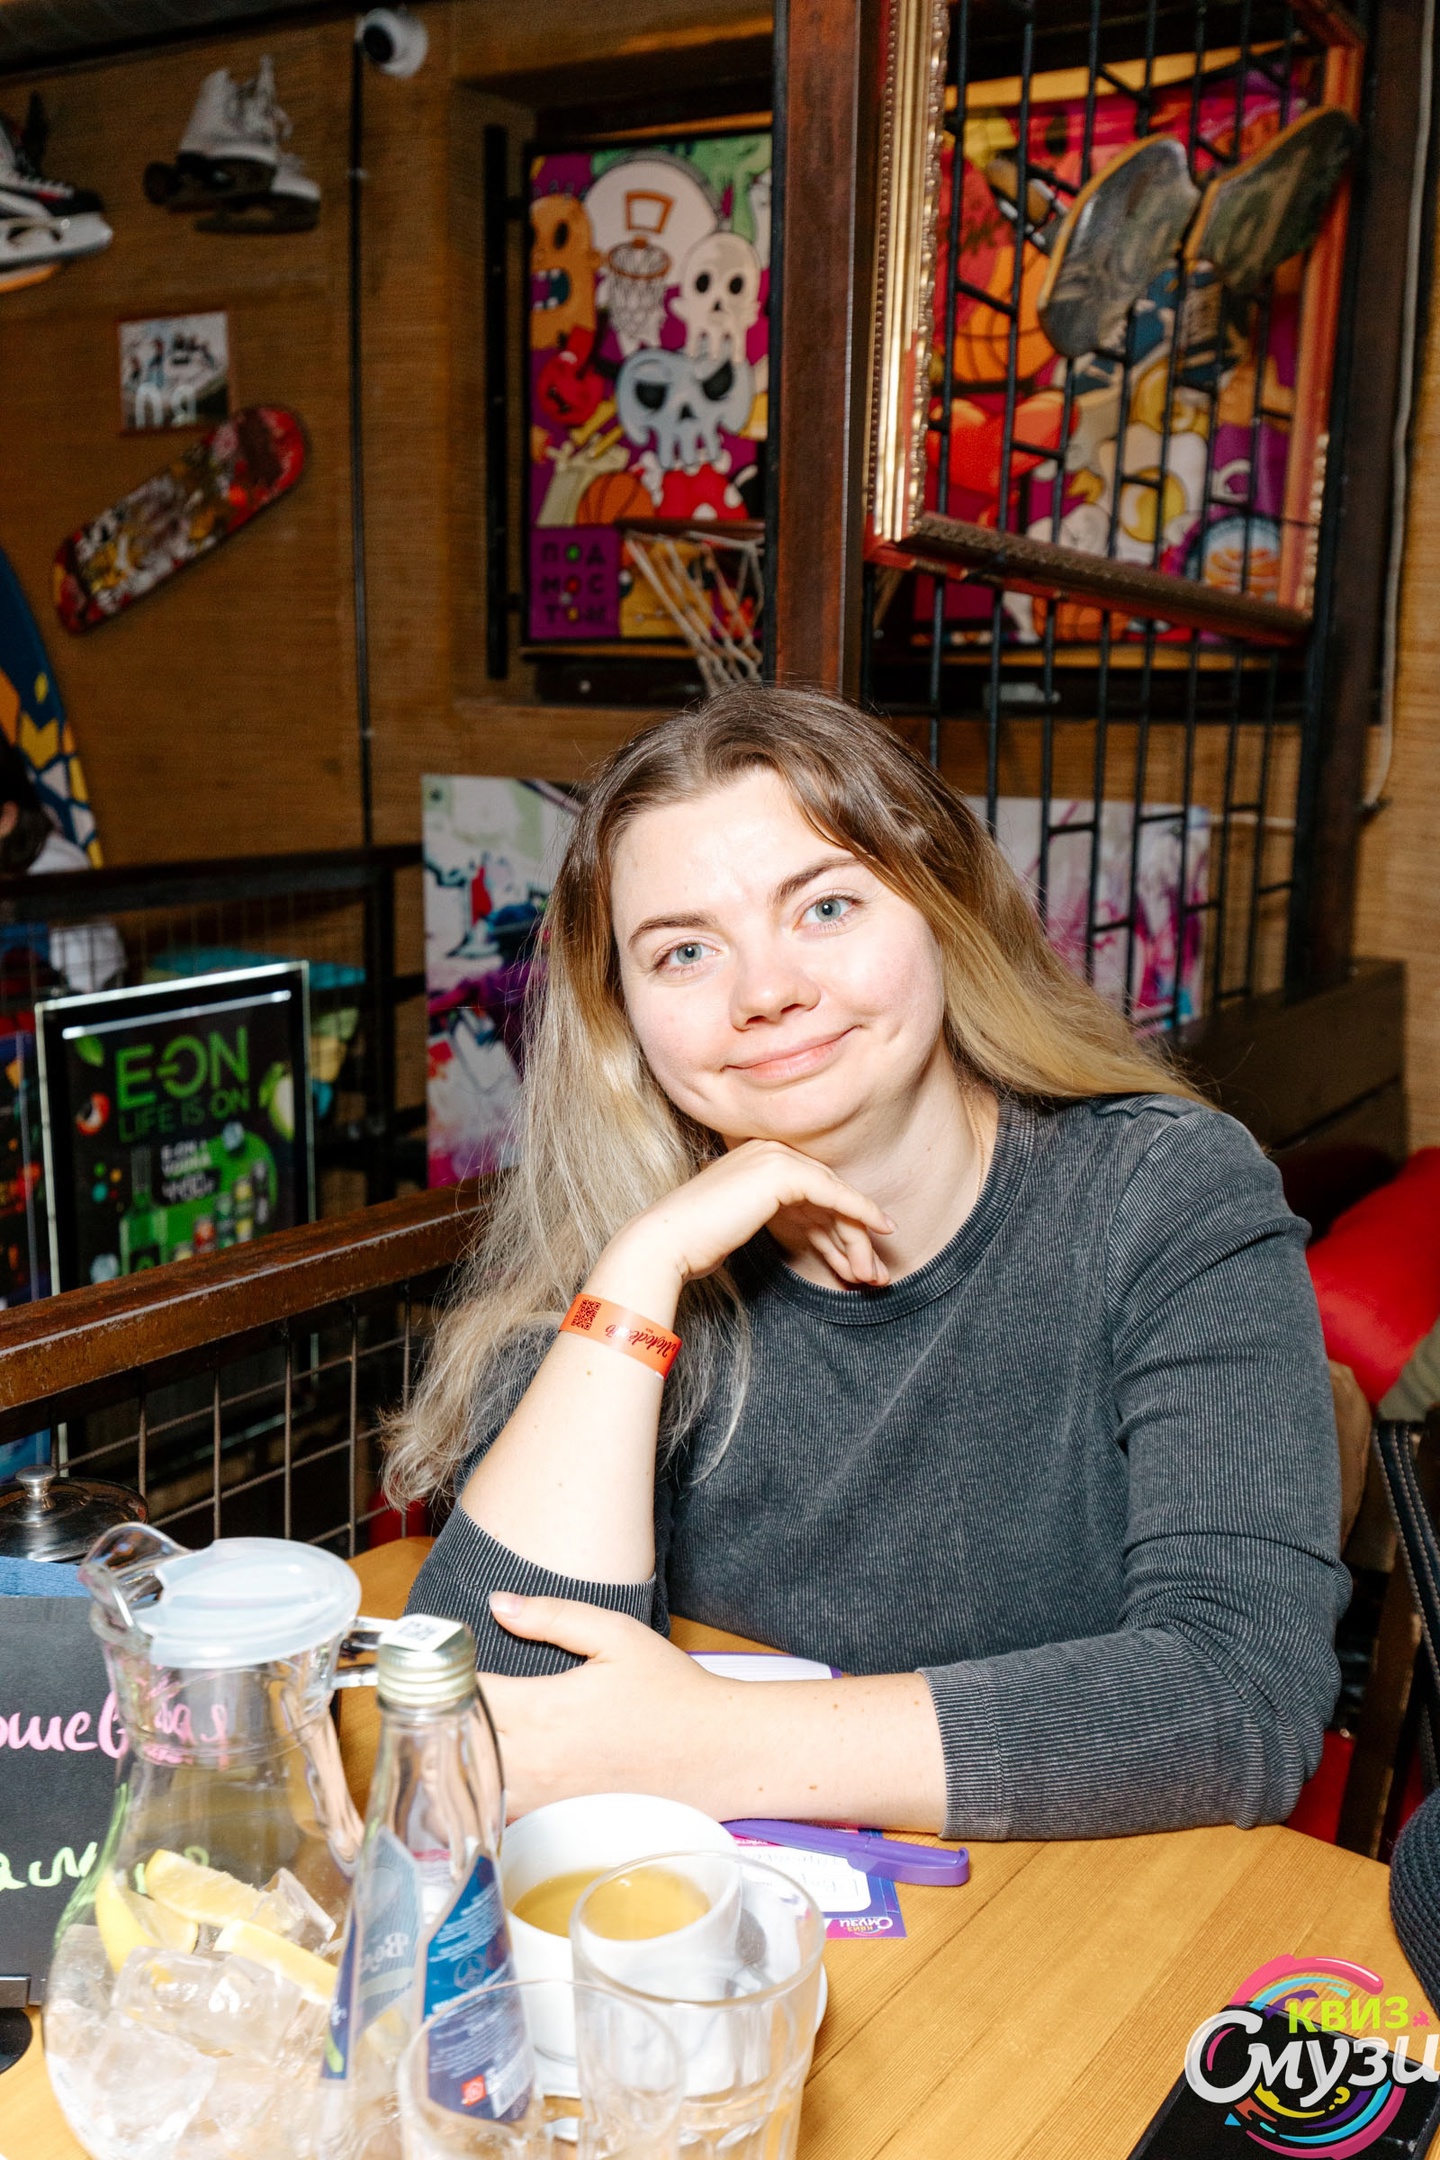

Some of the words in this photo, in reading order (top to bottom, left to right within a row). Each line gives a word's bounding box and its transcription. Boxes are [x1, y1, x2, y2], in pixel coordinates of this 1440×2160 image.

[118, 1102, 177, 1144] LIFE
[180, 1098, 206, 1128] IS
[210, 1085, 250, 1121] ON
[839, 1917, 894, 1930] Смузи
